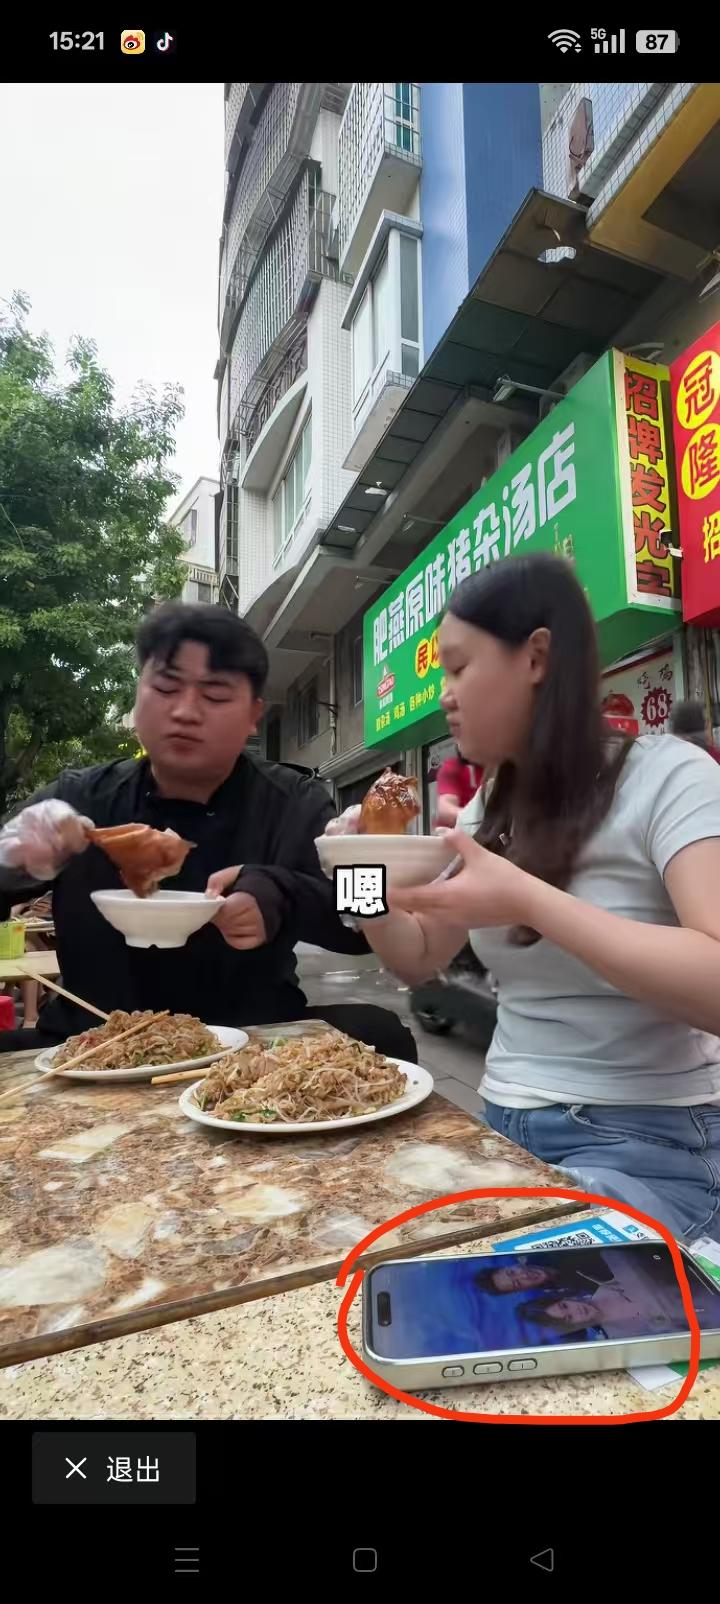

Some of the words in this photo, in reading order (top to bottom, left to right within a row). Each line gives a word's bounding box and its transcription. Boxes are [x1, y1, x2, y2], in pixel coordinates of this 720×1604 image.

[373, 422, 577, 667] 肥燕原味猪杂汤店
[625, 368, 671, 598] 招牌发光字
[646, 693, 668, 721] 68
